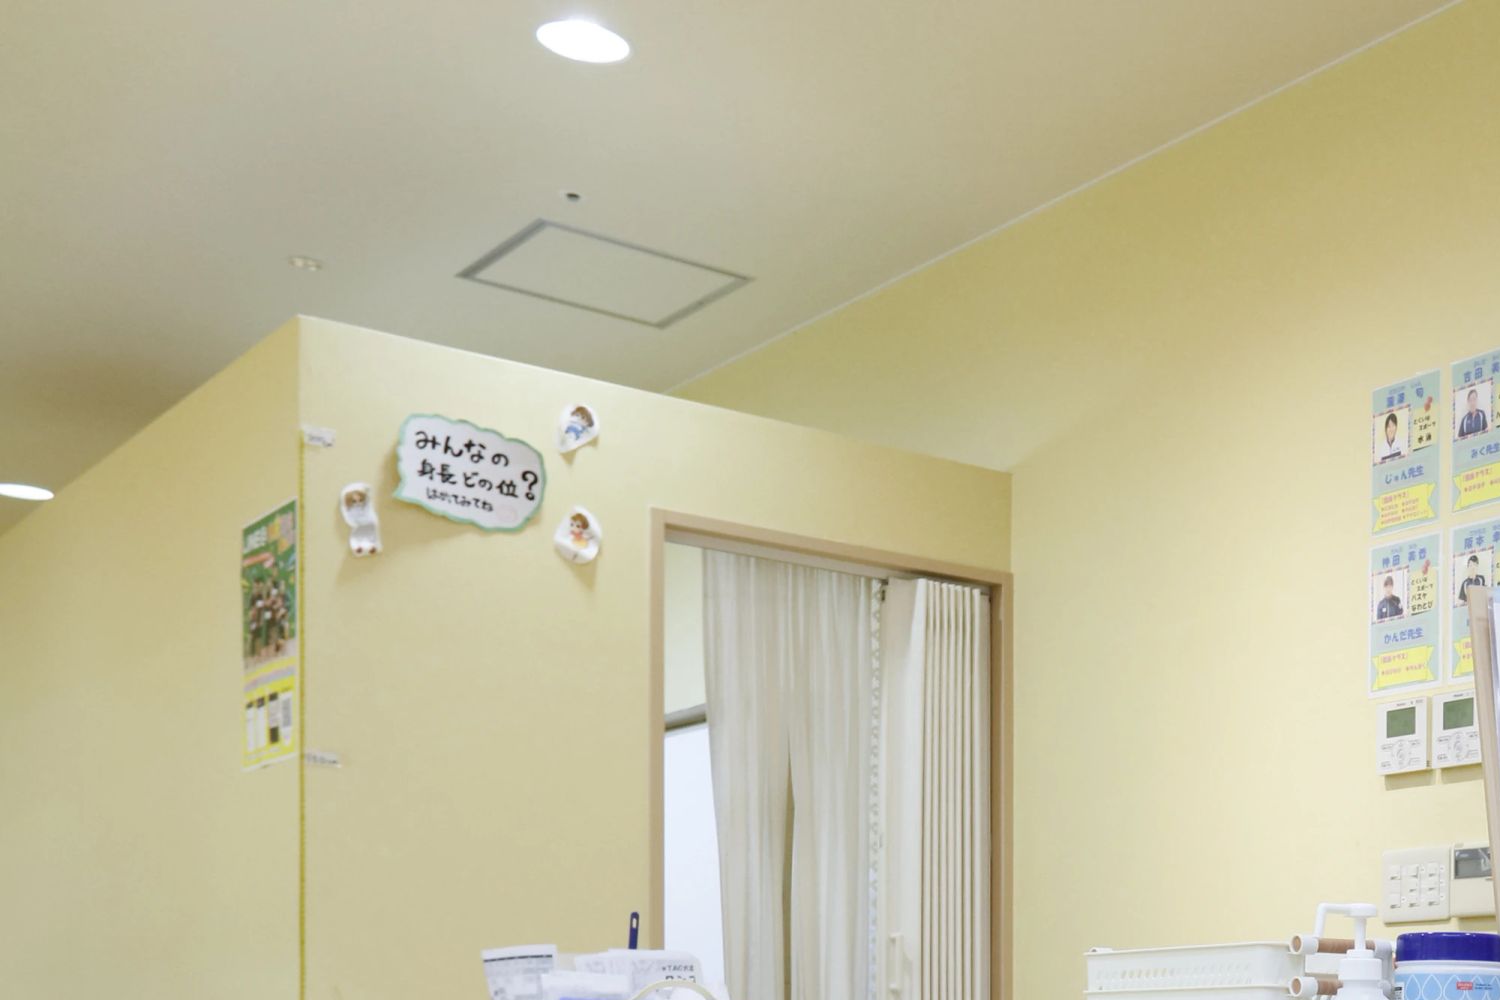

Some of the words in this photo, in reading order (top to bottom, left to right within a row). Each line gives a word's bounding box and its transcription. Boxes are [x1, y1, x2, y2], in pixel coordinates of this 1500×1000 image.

[415, 430, 510, 468] みんなの
[1471, 442, 1500, 459] みく先生
[1385, 465, 1424, 485] じゅん先生
